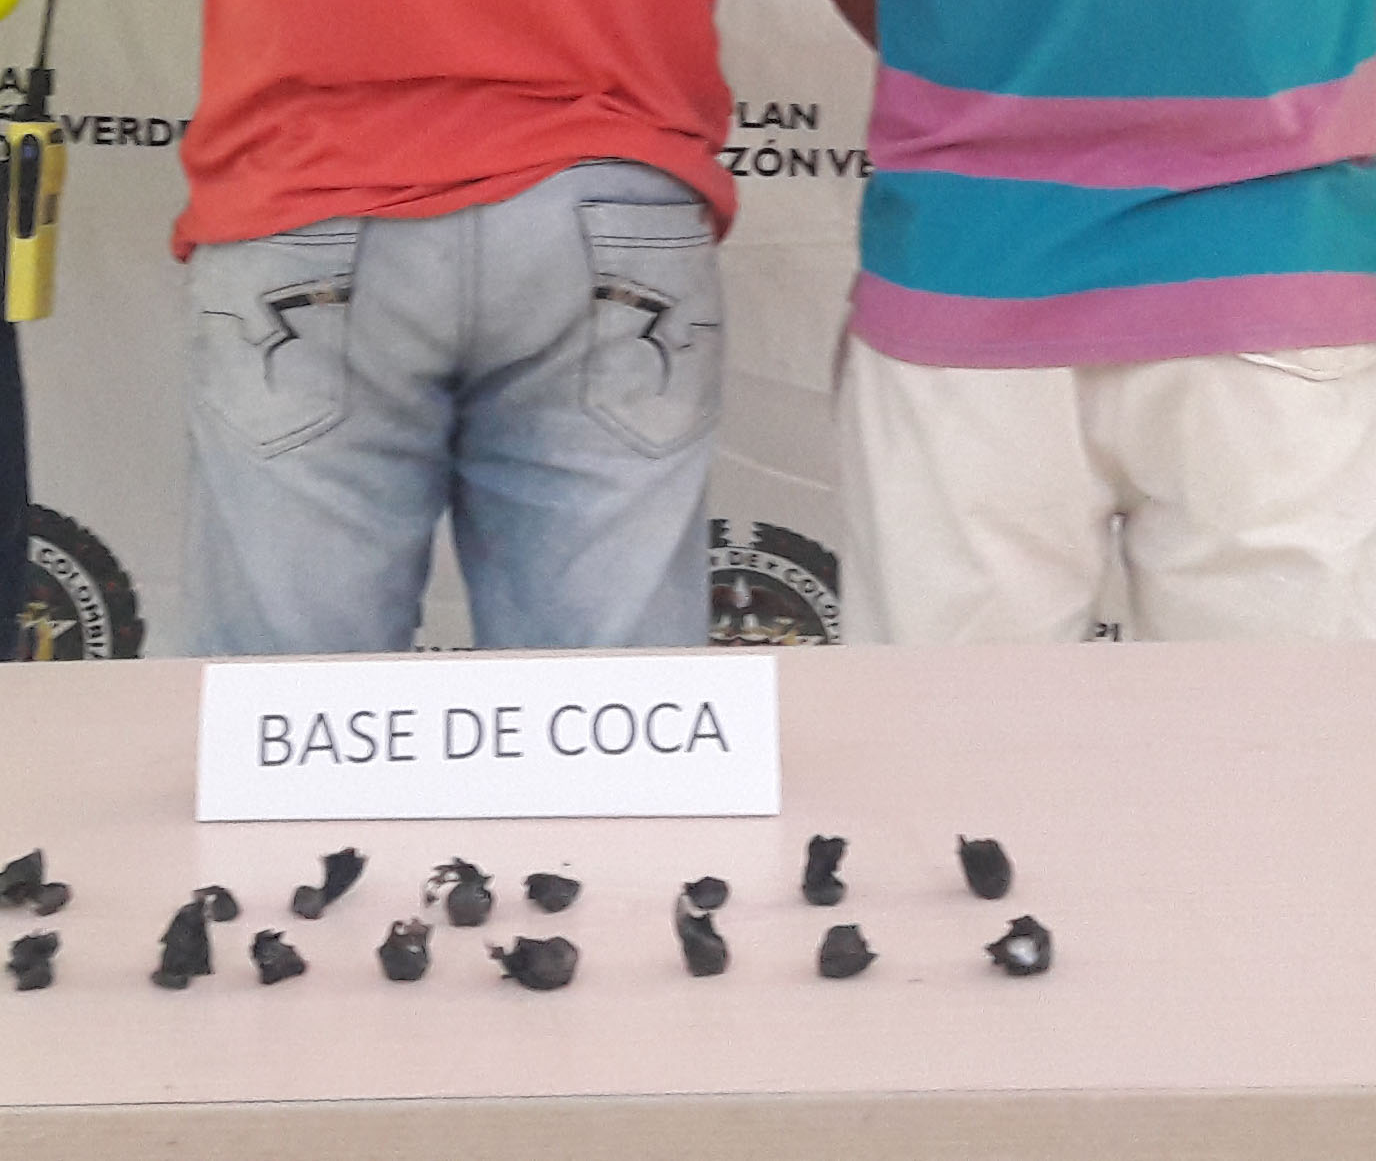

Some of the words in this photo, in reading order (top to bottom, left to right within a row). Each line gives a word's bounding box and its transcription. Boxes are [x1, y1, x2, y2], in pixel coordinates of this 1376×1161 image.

[735, 101, 820, 130] LAN
[258, 710, 418, 768] BASE
[443, 705, 523, 761] DE
[548, 700, 731, 757] COCA
